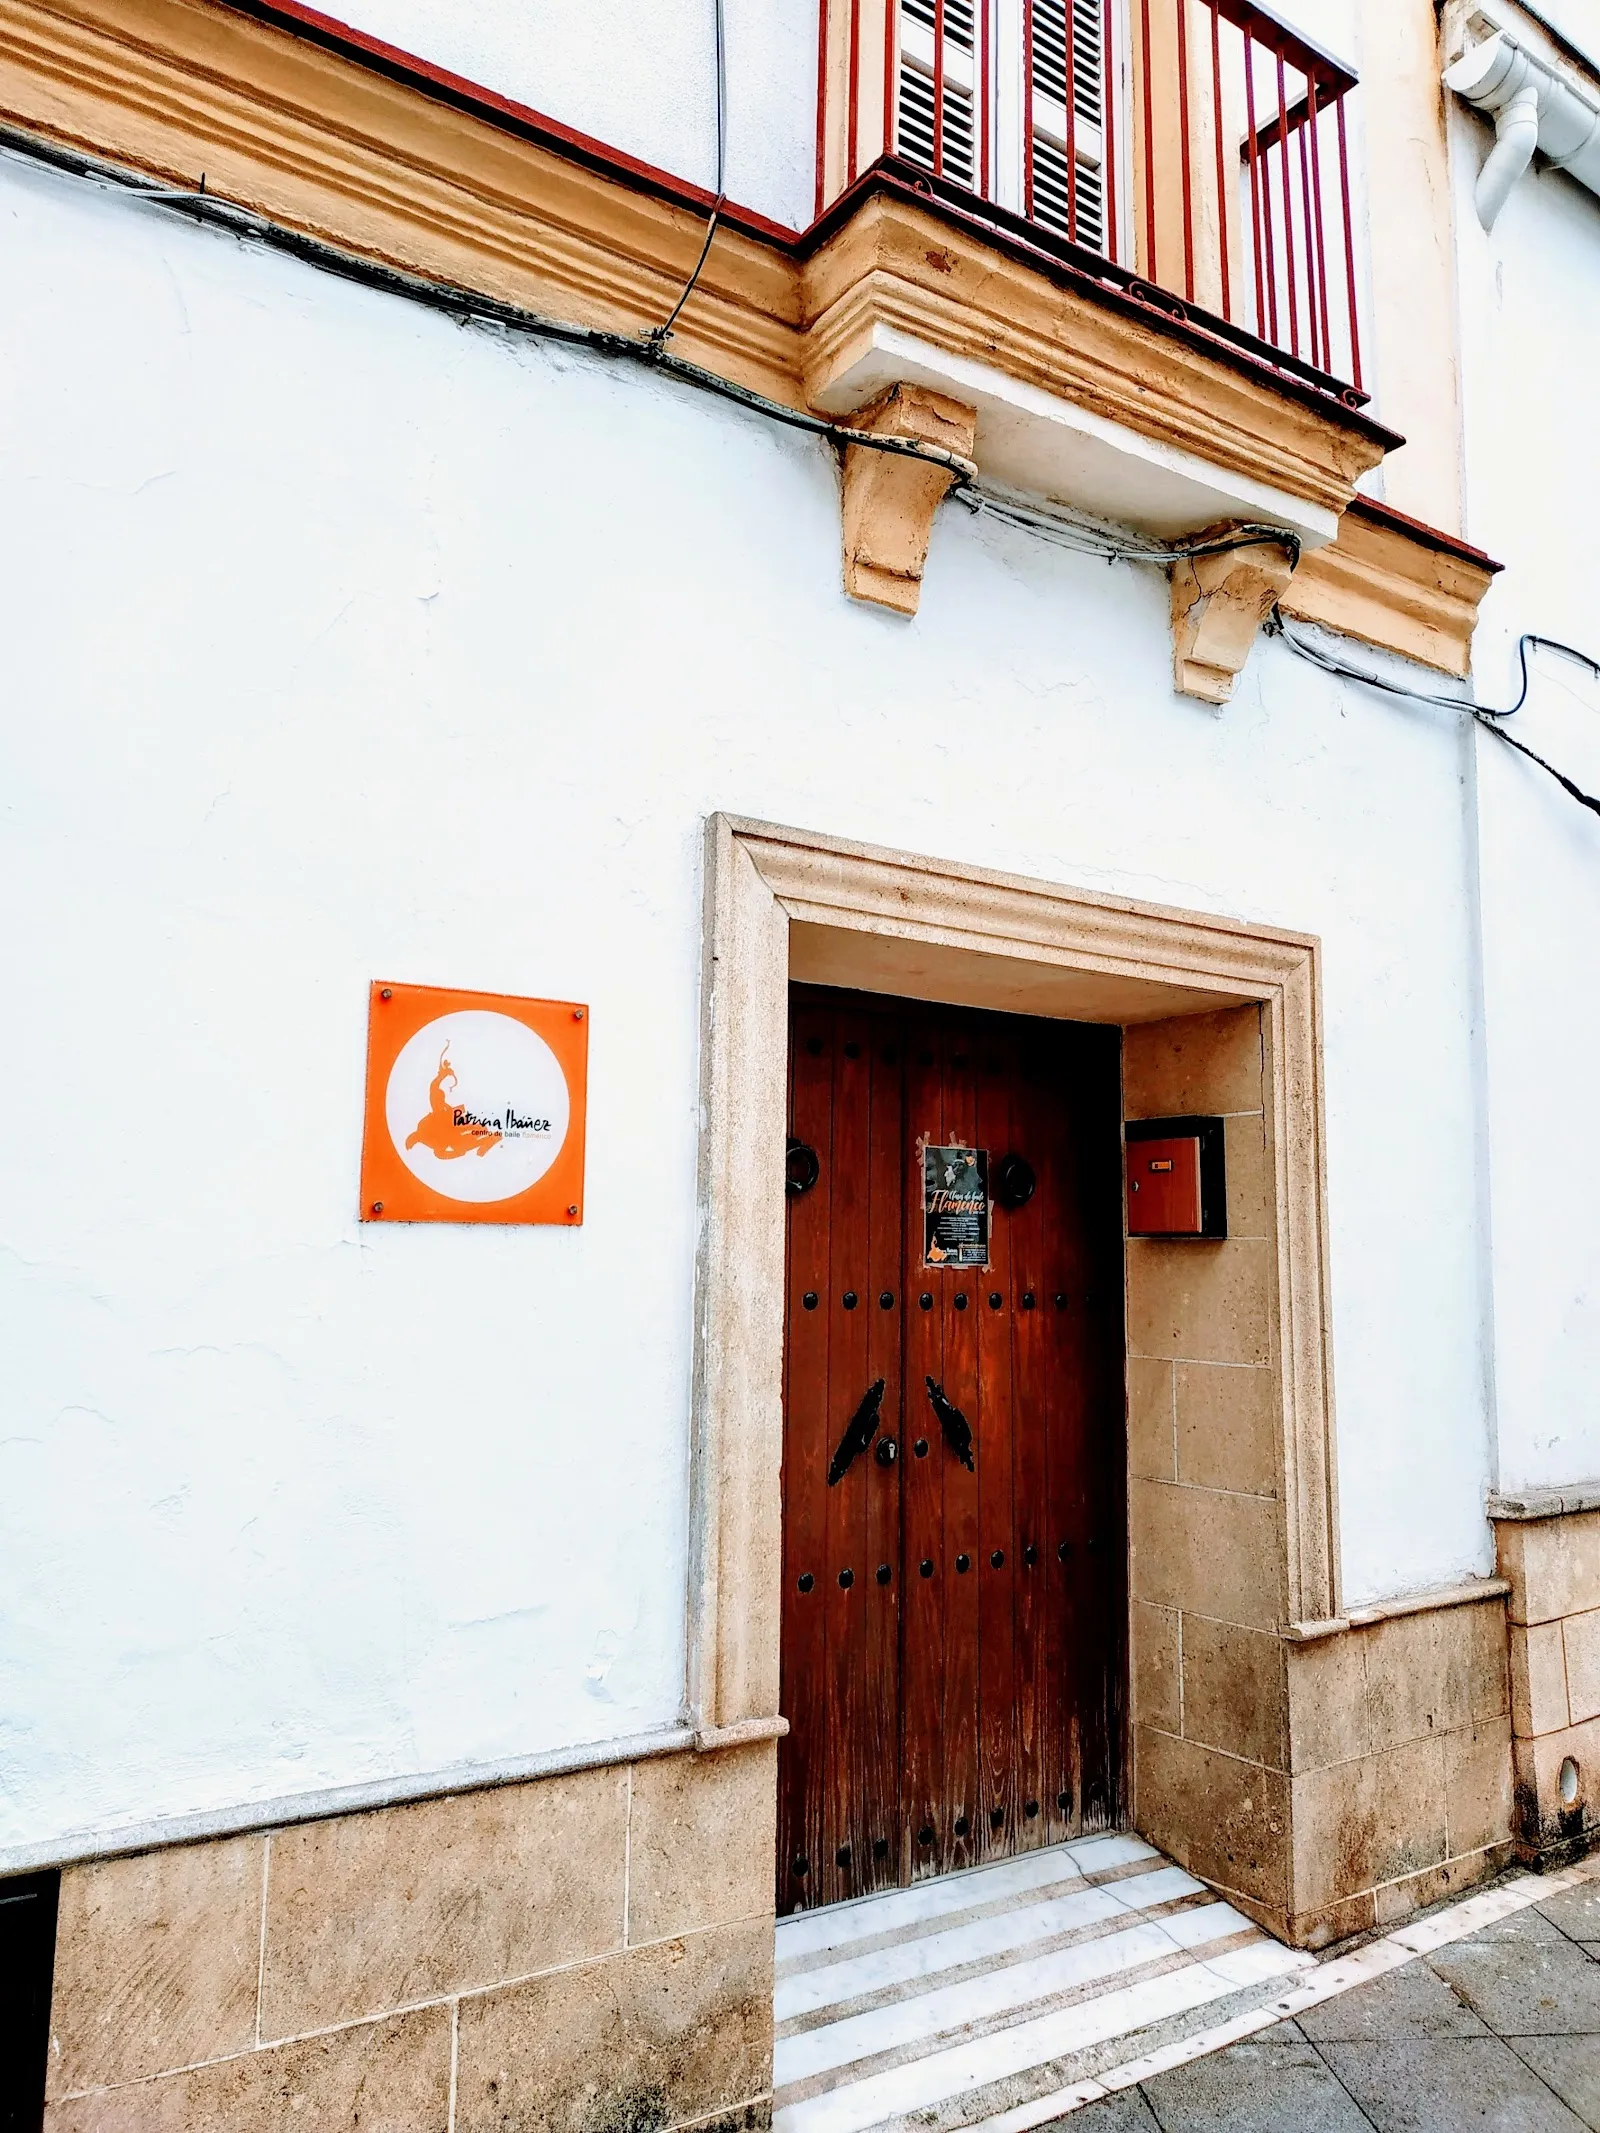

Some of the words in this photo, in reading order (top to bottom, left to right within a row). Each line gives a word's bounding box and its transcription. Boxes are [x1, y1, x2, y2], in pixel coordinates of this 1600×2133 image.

[453, 1109, 502, 1130] Patricia
[505, 1108, 552, 1131] Ibáñez
[471, 1129, 493, 1137] centro
[928, 1190, 986, 1215] Flamenco
